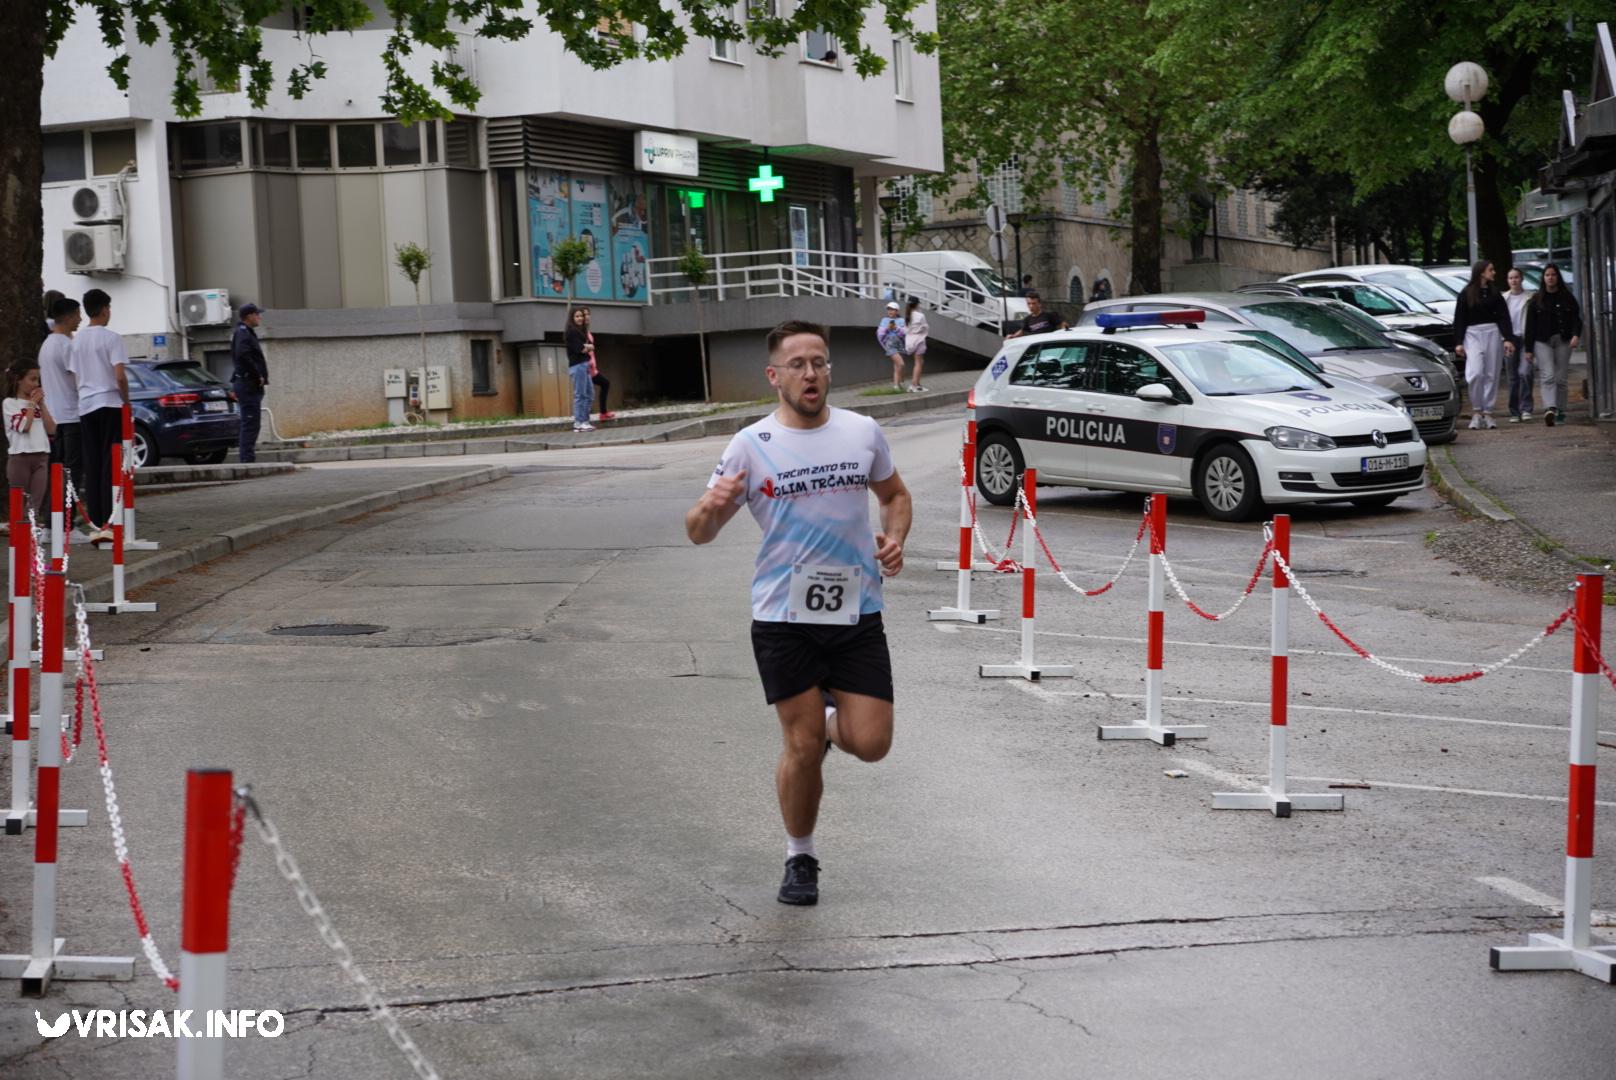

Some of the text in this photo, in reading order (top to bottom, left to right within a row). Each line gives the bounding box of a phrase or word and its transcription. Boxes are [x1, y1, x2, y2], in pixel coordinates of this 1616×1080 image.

[1297, 403, 1390, 418] POLICIJA
[1046, 416, 1126, 444] POLICIJA
[811, 464, 838, 475] ZATO
[805, 583, 844, 612] 63
